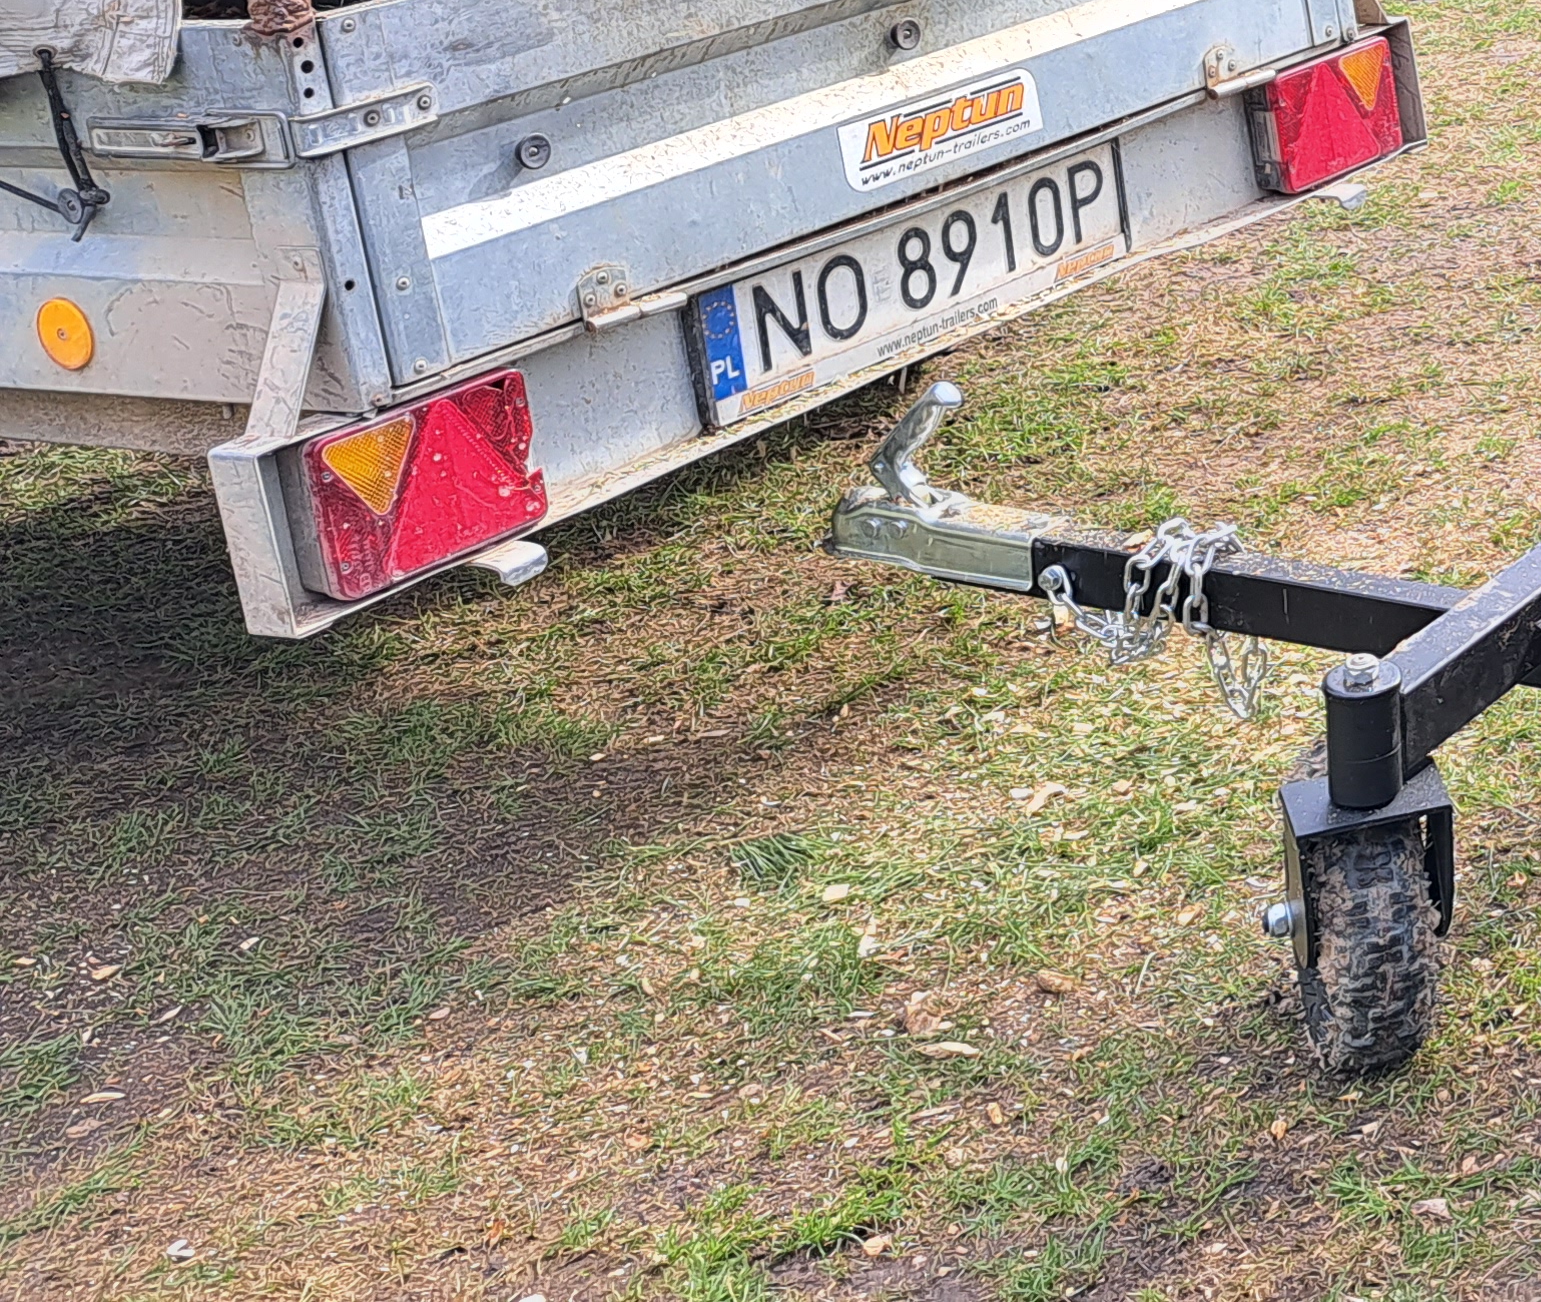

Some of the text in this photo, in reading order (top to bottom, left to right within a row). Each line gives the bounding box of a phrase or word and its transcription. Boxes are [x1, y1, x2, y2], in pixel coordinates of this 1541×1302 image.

[860, 83, 1025, 164] Neptun
[861, 118, 1031, 186] www.neptun-trailers.com
[752, 159, 1103, 372] NO 8910P
[876, 296, 998, 358] www.neptun-trailers.com
[710, 356, 740, 385] PL
